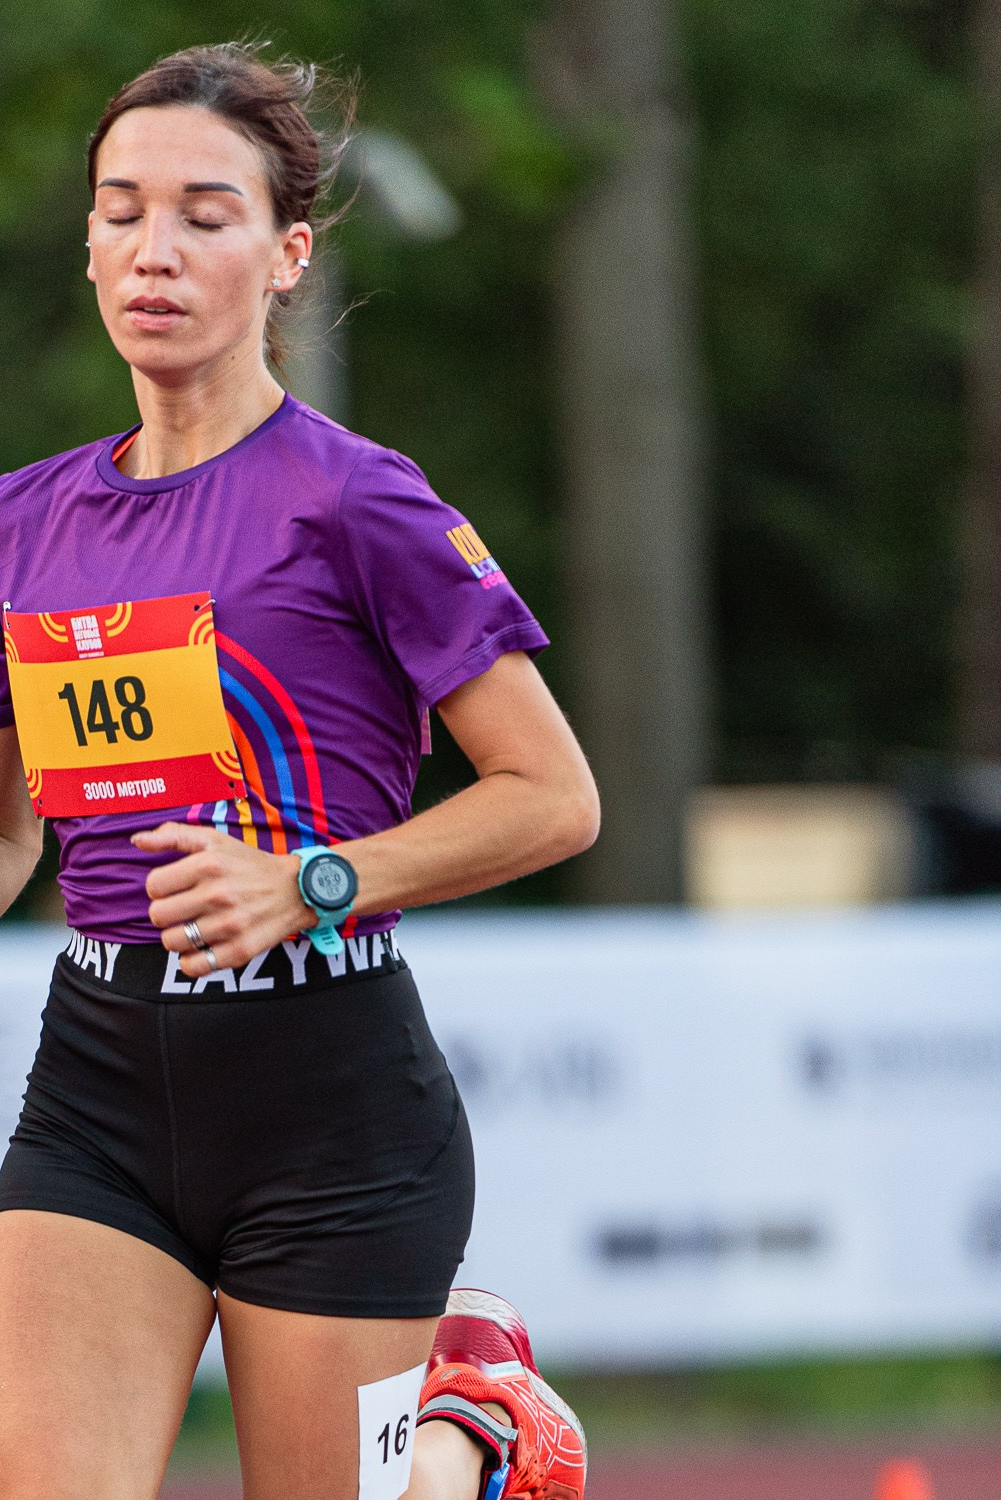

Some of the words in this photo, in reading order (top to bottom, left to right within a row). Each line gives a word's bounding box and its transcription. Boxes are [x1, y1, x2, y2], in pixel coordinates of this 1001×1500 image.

[58, 675, 153, 747] 148
[83, 780, 116, 801] 3000
[116, 777, 167, 799] метров
[377, 1413, 409, 1465] 16
